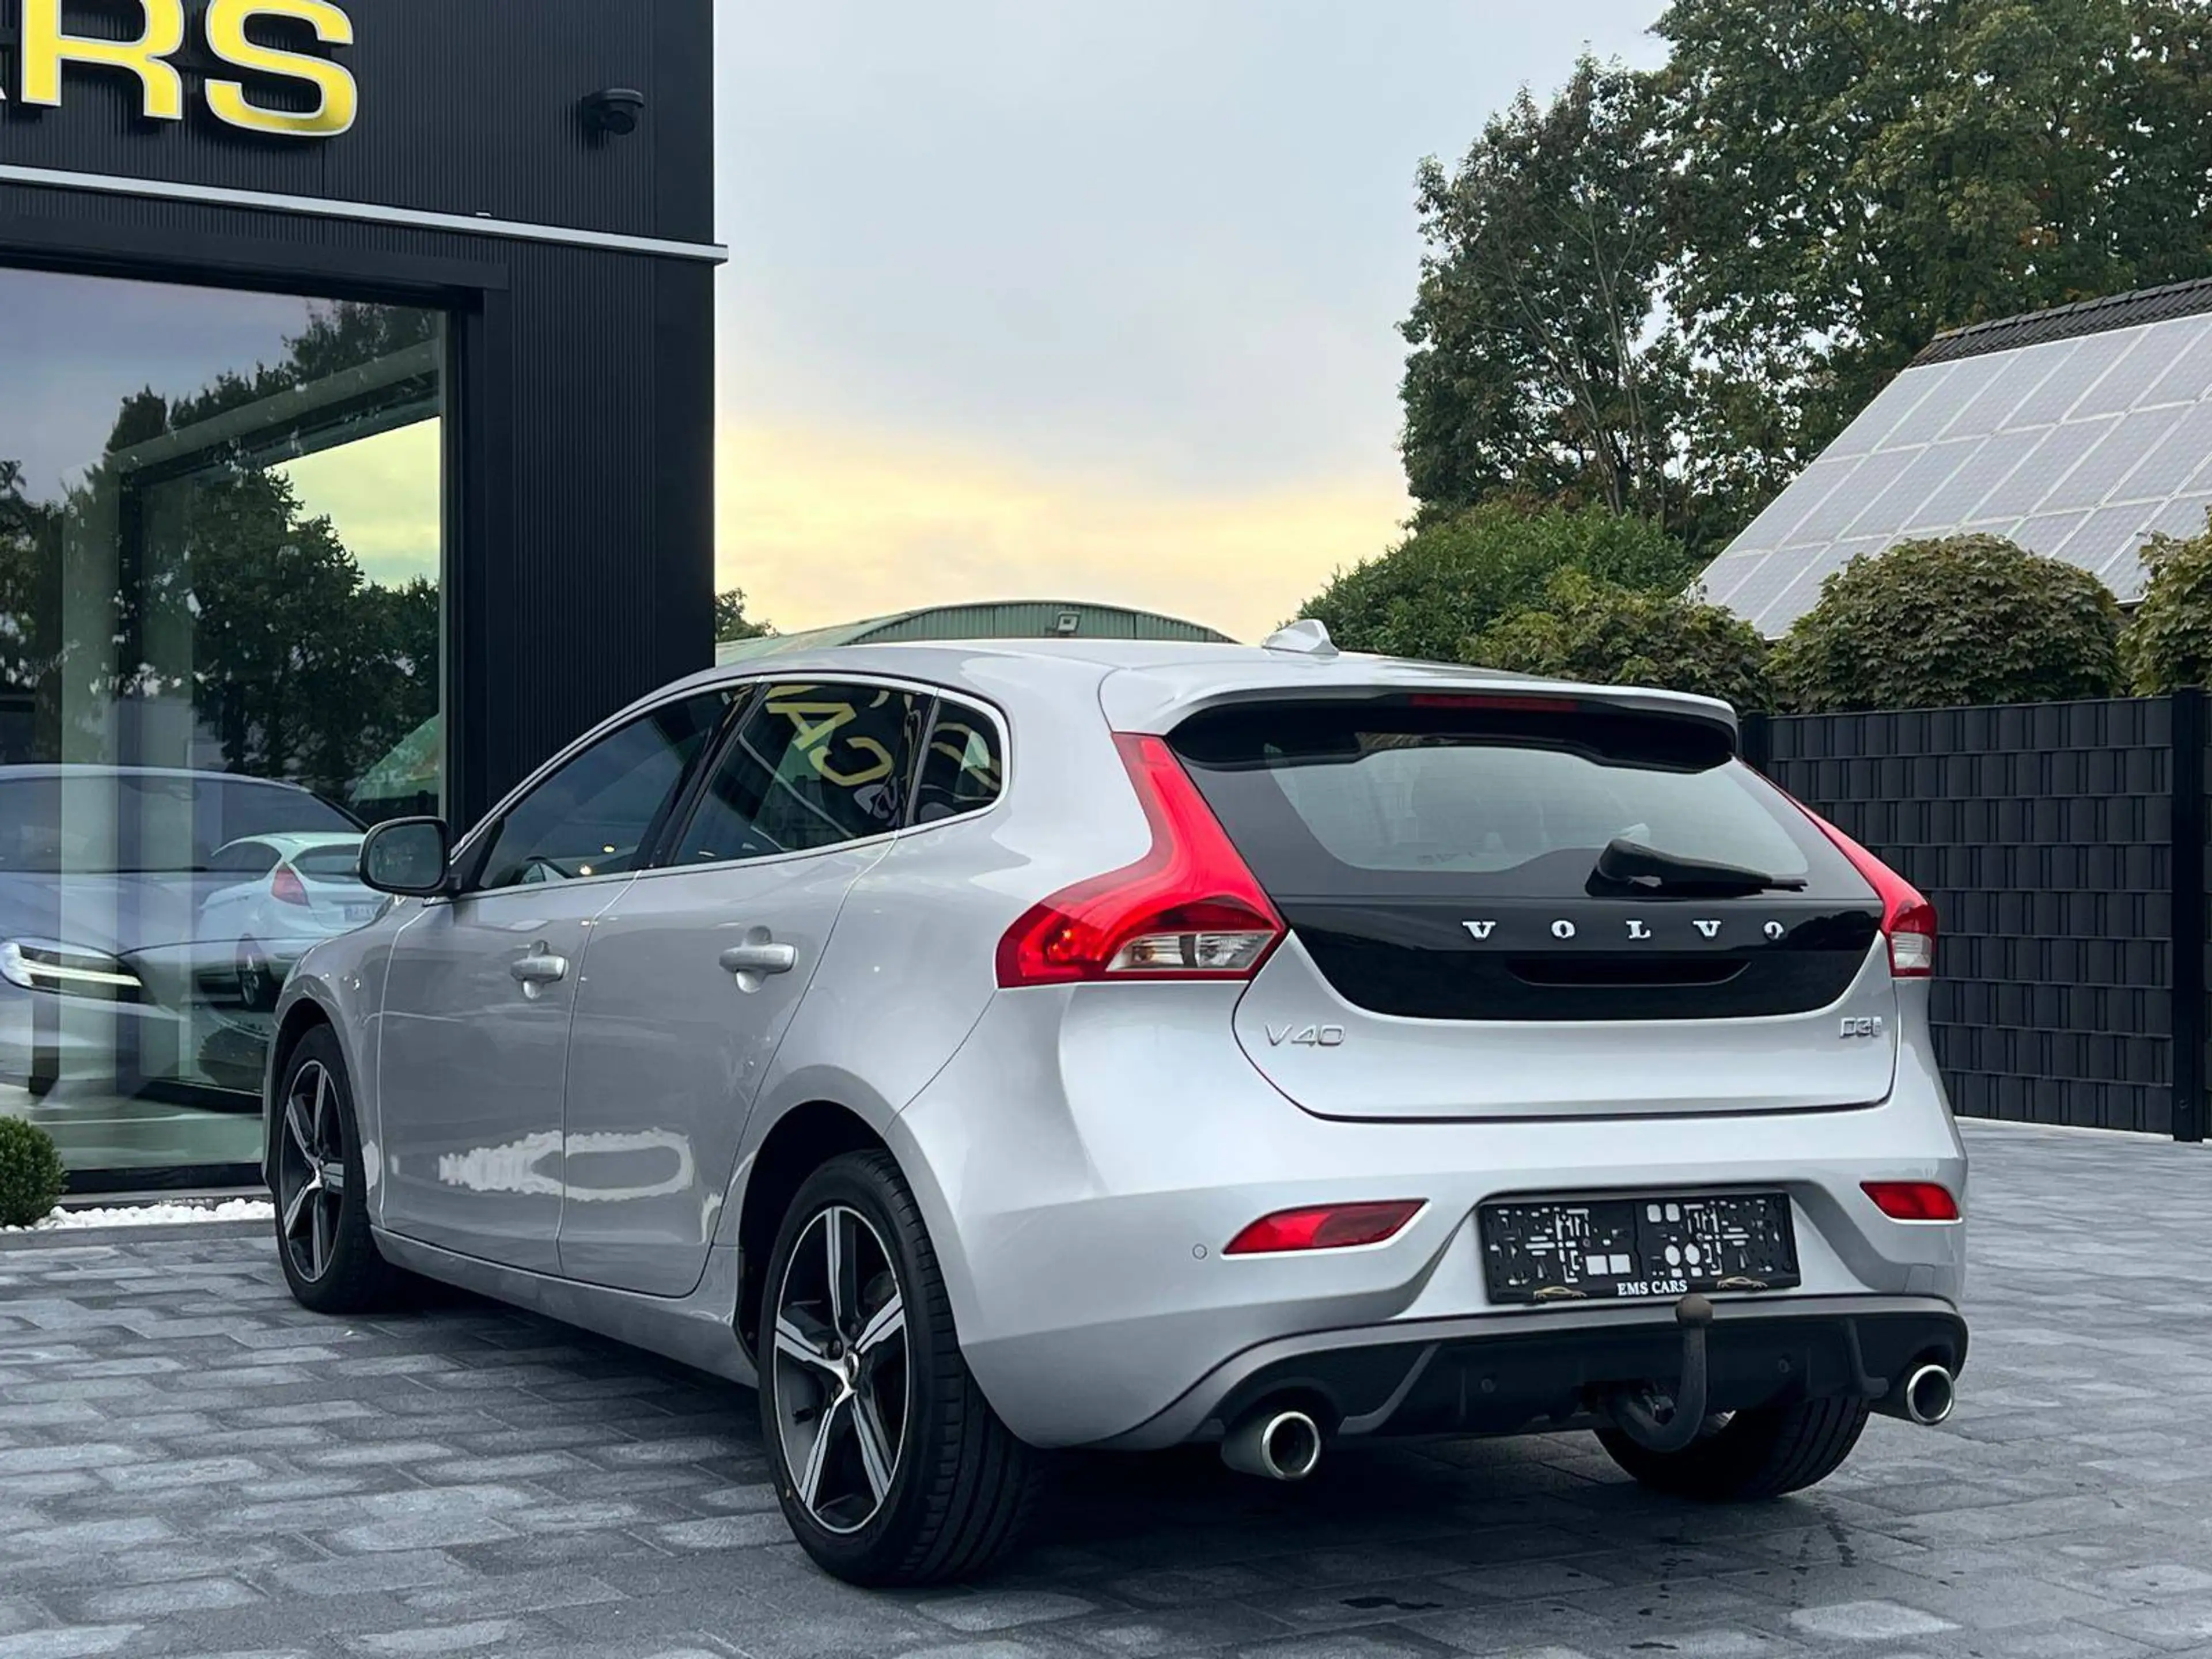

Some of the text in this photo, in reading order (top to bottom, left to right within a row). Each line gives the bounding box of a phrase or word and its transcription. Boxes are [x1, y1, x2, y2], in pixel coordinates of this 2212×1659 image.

[0, 0, 357, 137] RS
[1462, 920, 1784, 940] VOLVO
[1265, 1023, 1346, 1047] V40
[1616, 1279, 1688, 1296] EMS CARS
